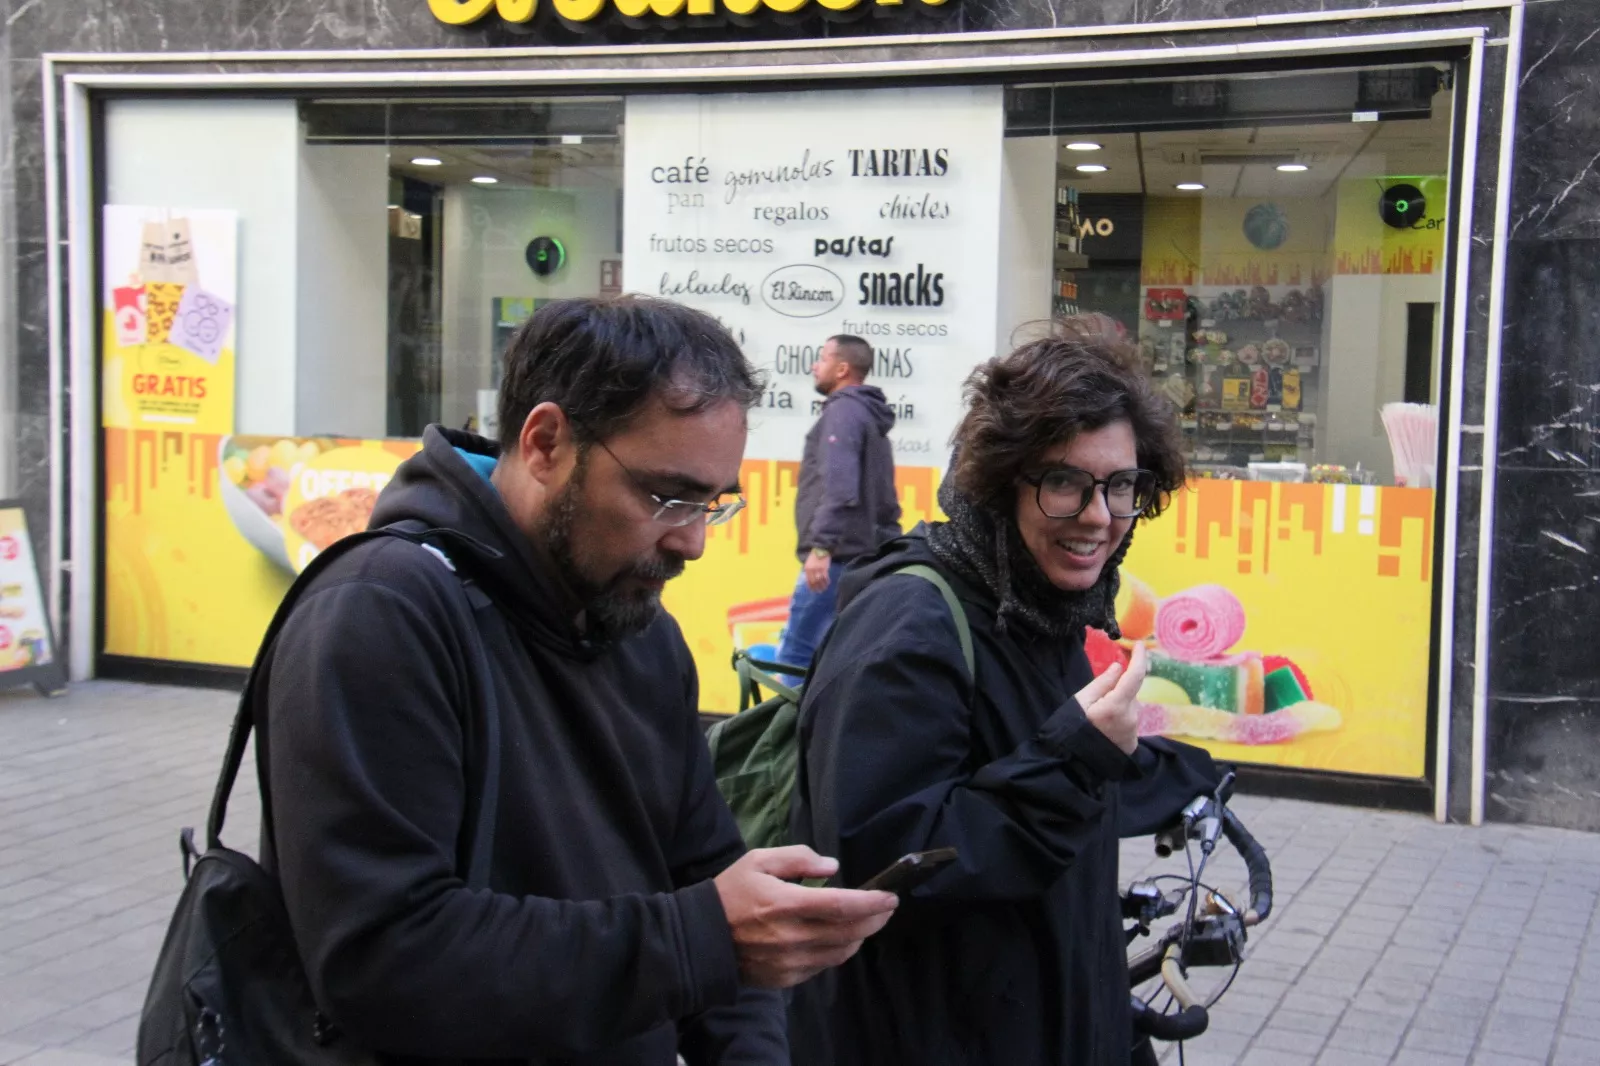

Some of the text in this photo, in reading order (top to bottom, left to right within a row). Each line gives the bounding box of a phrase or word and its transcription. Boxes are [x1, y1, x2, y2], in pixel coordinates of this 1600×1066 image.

[651, 156, 709, 183] café
[724, 148, 835, 204] gominolas
[848, 148, 949, 177] TARTAS
[667, 192, 705, 214] pan
[753, 201, 829, 226] regalos
[879, 192, 950, 220] chicles
[650, 234, 774, 253] frutos secos
[815, 236, 894, 258] pastas
[659, 270, 750, 305] helados
[859, 263, 944, 307] snacks
[842, 320, 948, 337] frutos secos
[775, 345, 913, 379] CHOINAS
[133, 374, 207, 399] GRATIS
[301, 469, 392, 501] OFERT
